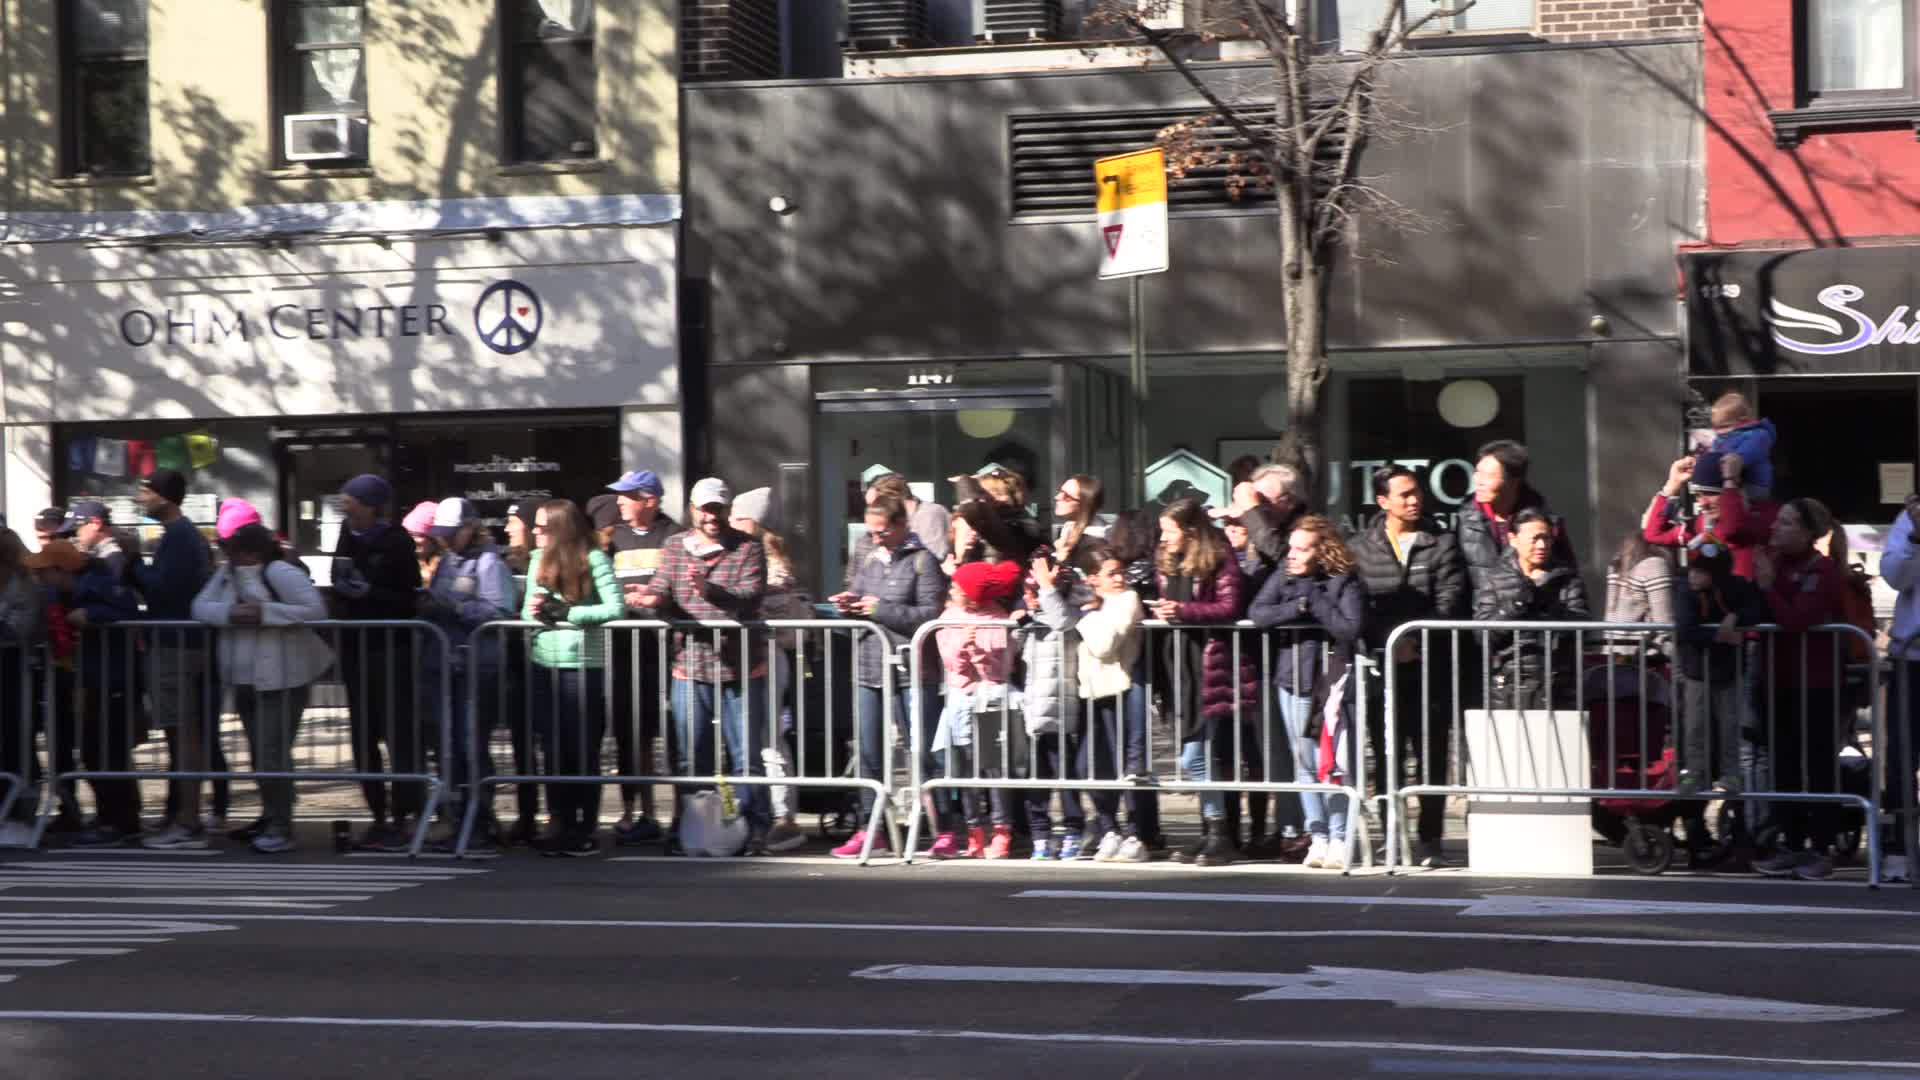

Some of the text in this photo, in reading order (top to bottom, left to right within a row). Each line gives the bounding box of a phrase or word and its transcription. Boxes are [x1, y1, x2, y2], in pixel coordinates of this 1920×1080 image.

[120, 303, 457, 347] OHM CENTER
[453, 454, 561, 473] meditation
[464, 482, 553, 500] wellness
